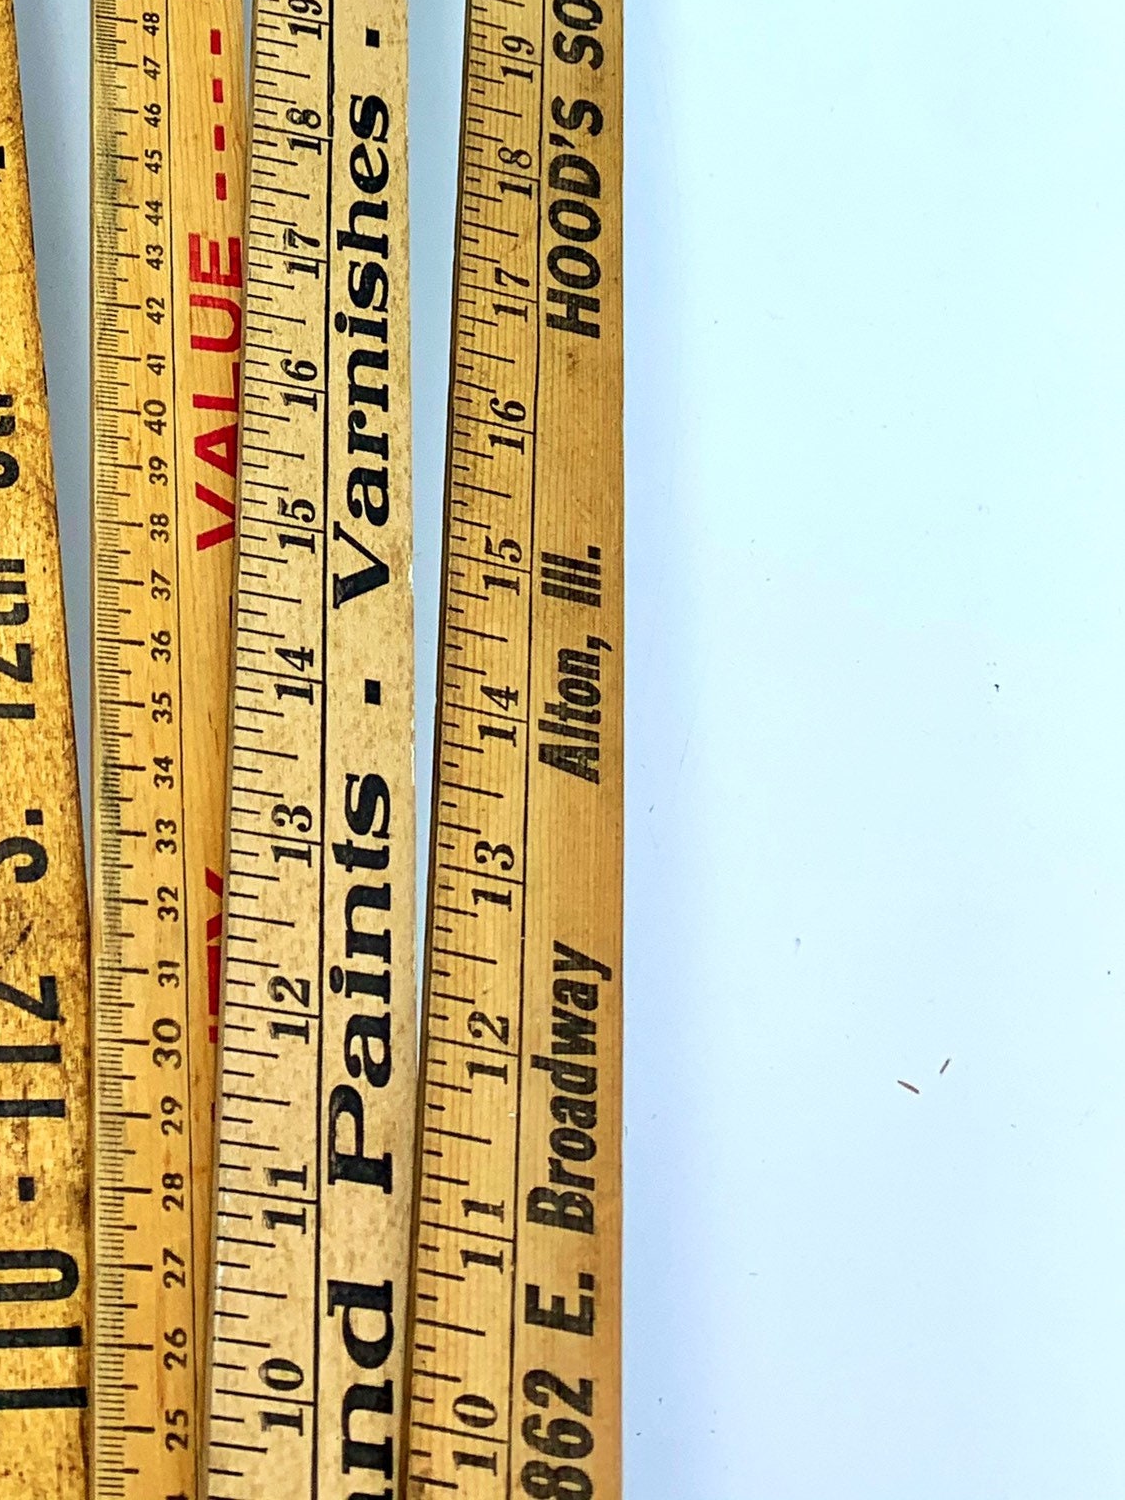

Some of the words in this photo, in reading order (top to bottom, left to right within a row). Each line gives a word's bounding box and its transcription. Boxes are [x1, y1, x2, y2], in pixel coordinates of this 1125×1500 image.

[143, 12, 160, 37] 48
[144, 103, 162, 128] 46
[286, 108, 322, 156] 18
[498, 147, 532, 200] 18
[145, 199, 163, 226] 44
[546, 95, 604, 339] HOOD'S
[147, 297, 165, 325] 42
[333, 94, 390, 610] Varnishes
[188, 232, 242, 551] VALUE
[280, 358, 318, 412] 16
[144, 398, 167, 436] 40
[488, 397, 526, 455] 16
[150, 512, 170, 543] 38
[482, 535, 522, 596] 15
[152, 630, 172, 663] 36
[275, 646, 314, 705] 14
[538, 634, 613, 785] Alton,
[154, 755, 175, 789] 34
[271, 804, 312, 868] 13
[157, 886, 179, 923] 32
[472, 840, 514, 912] 13
[268, 975, 310, 1044] 12
[328, 773, 393, 1194] Paints
[152, 1018, 182, 1070] 30
[466, 1011, 509, 1086] 12
[525, 939, 612, 1235] Broadway
[162, 1172, 185, 1212] 28
[525, 1272, 595, 1337] E.
[163, 1327, 188, 1371] 26
[259, 1358, 304, 1437] 10
[326, 1280, 394, 1500] nd
[165, 1408, 189, 1450] 25
[452, 1394, 497, 1476] 10
